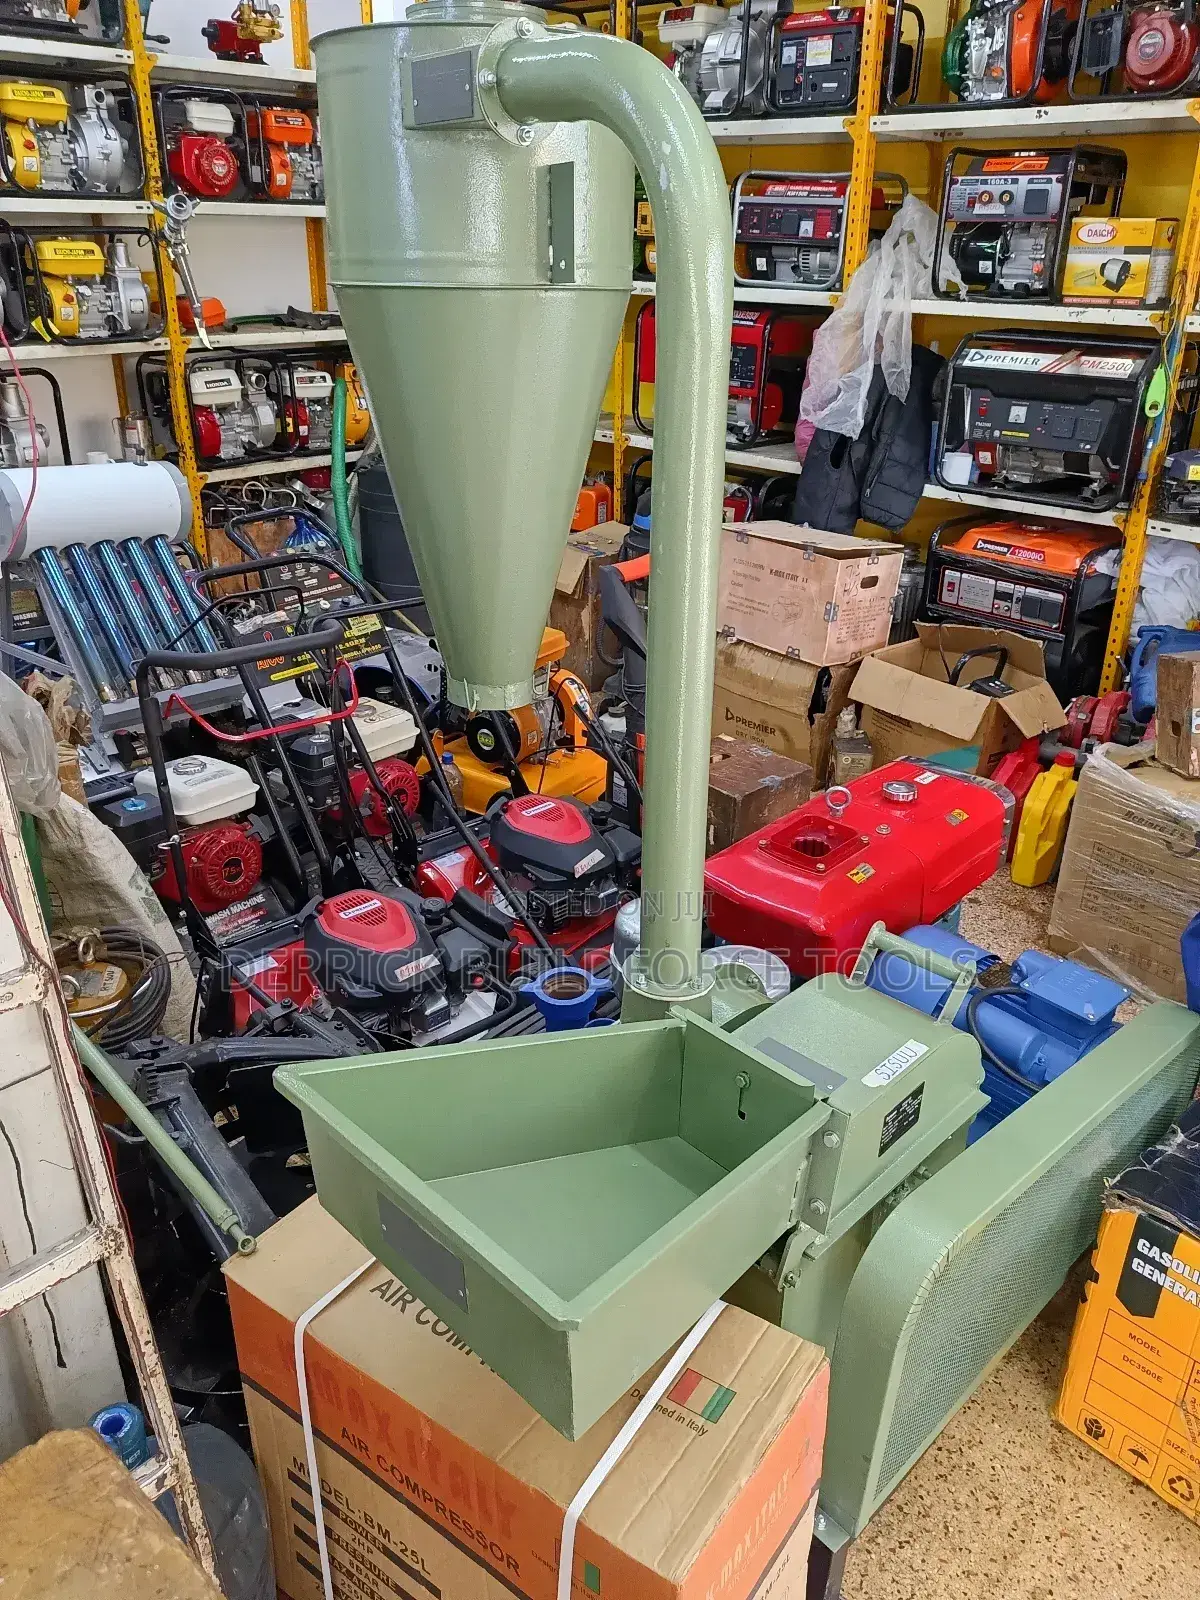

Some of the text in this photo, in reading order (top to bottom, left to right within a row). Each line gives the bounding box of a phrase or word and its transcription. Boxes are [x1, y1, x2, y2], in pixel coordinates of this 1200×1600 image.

[984, 354, 1134, 372] PREMIER PM2500
[206, 381, 230, 389] HONDA
[983, 543, 1009, 553] PREMIER
[735, 715, 777, 737] PREMIER
[205, 893, 266, 924] WASH MACHINE
[237, 910, 265, 926] Pressure
[351, 901, 378, 914] PREMIER
[1136, 1237, 1200, 1287] GASOLI
[369, 1278, 417, 1315] AIR
[1127, 1331, 1163, 1359] MODEL
[1121, 1353, 1165, 1385] DC3500E
[676, 1412, 687, 1426] in
[686, 1414, 710, 1437] Italy
[292, 1455, 432, 1577] MDEL:BM-25L
[341, 1426, 522, 1579] AIR COMPRESSOR
[339, 1509, 386, 1553] POWER
[350, 1533, 374, 1556] 2HP
[332, 1530, 398, 1591] PRESSURE
[348, 1558, 382, 1591] 8BAR
